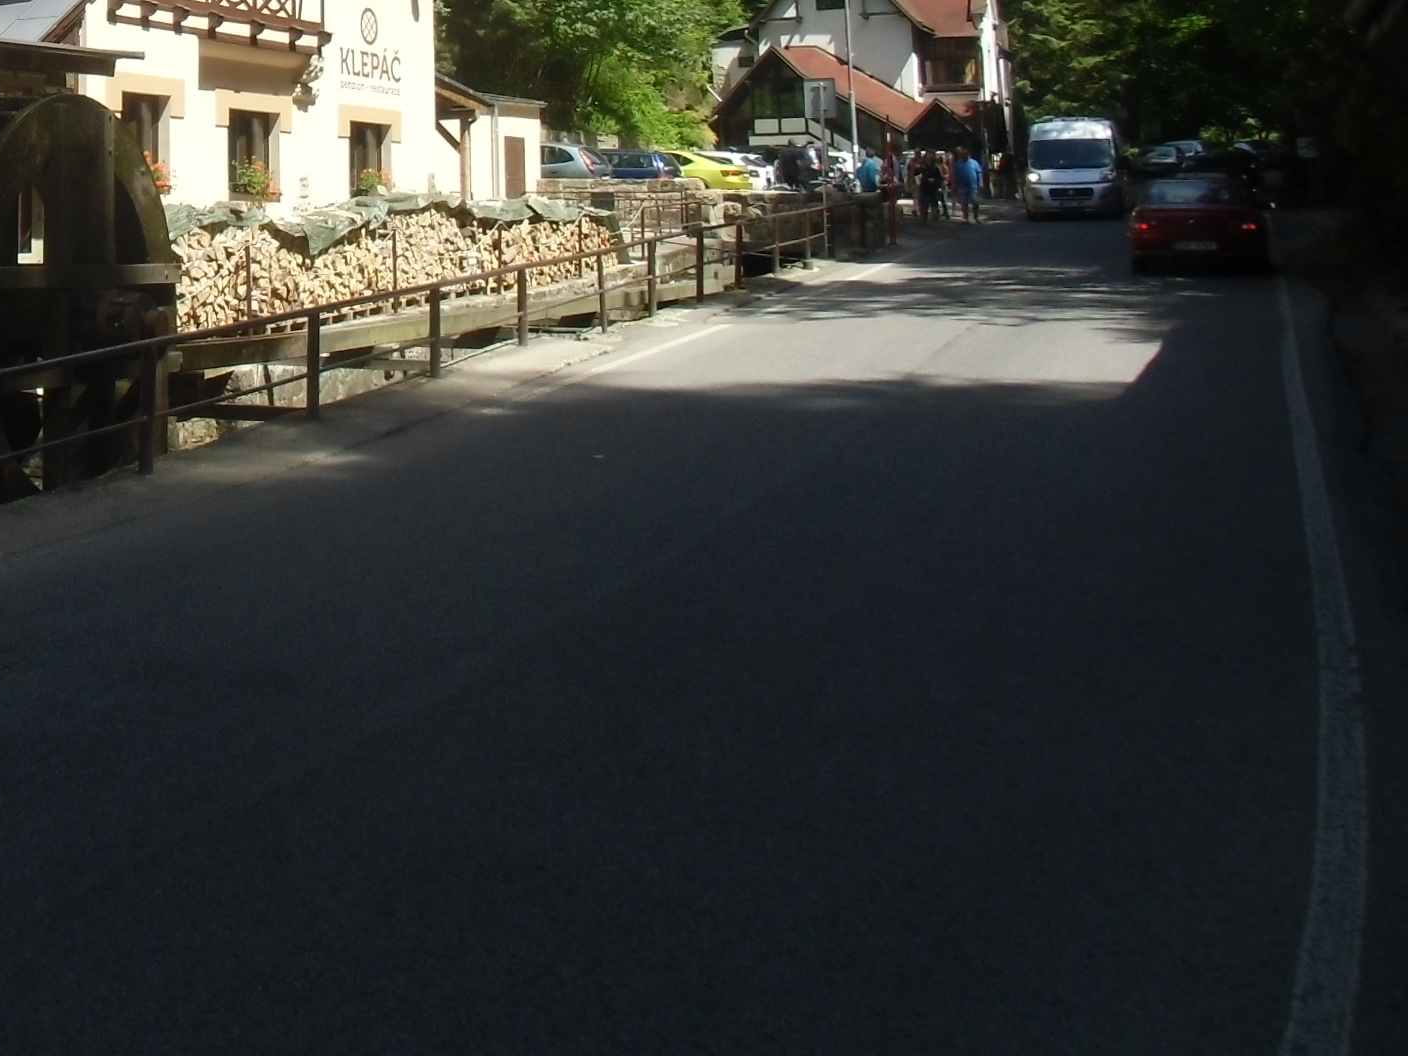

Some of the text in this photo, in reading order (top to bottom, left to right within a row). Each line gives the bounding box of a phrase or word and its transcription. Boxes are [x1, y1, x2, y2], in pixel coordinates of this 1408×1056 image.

[340, 47, 402, 83] KLEPÁČ
[340, 80, 365, 91] penzion
[370, 83, 401, 96] restaurace
